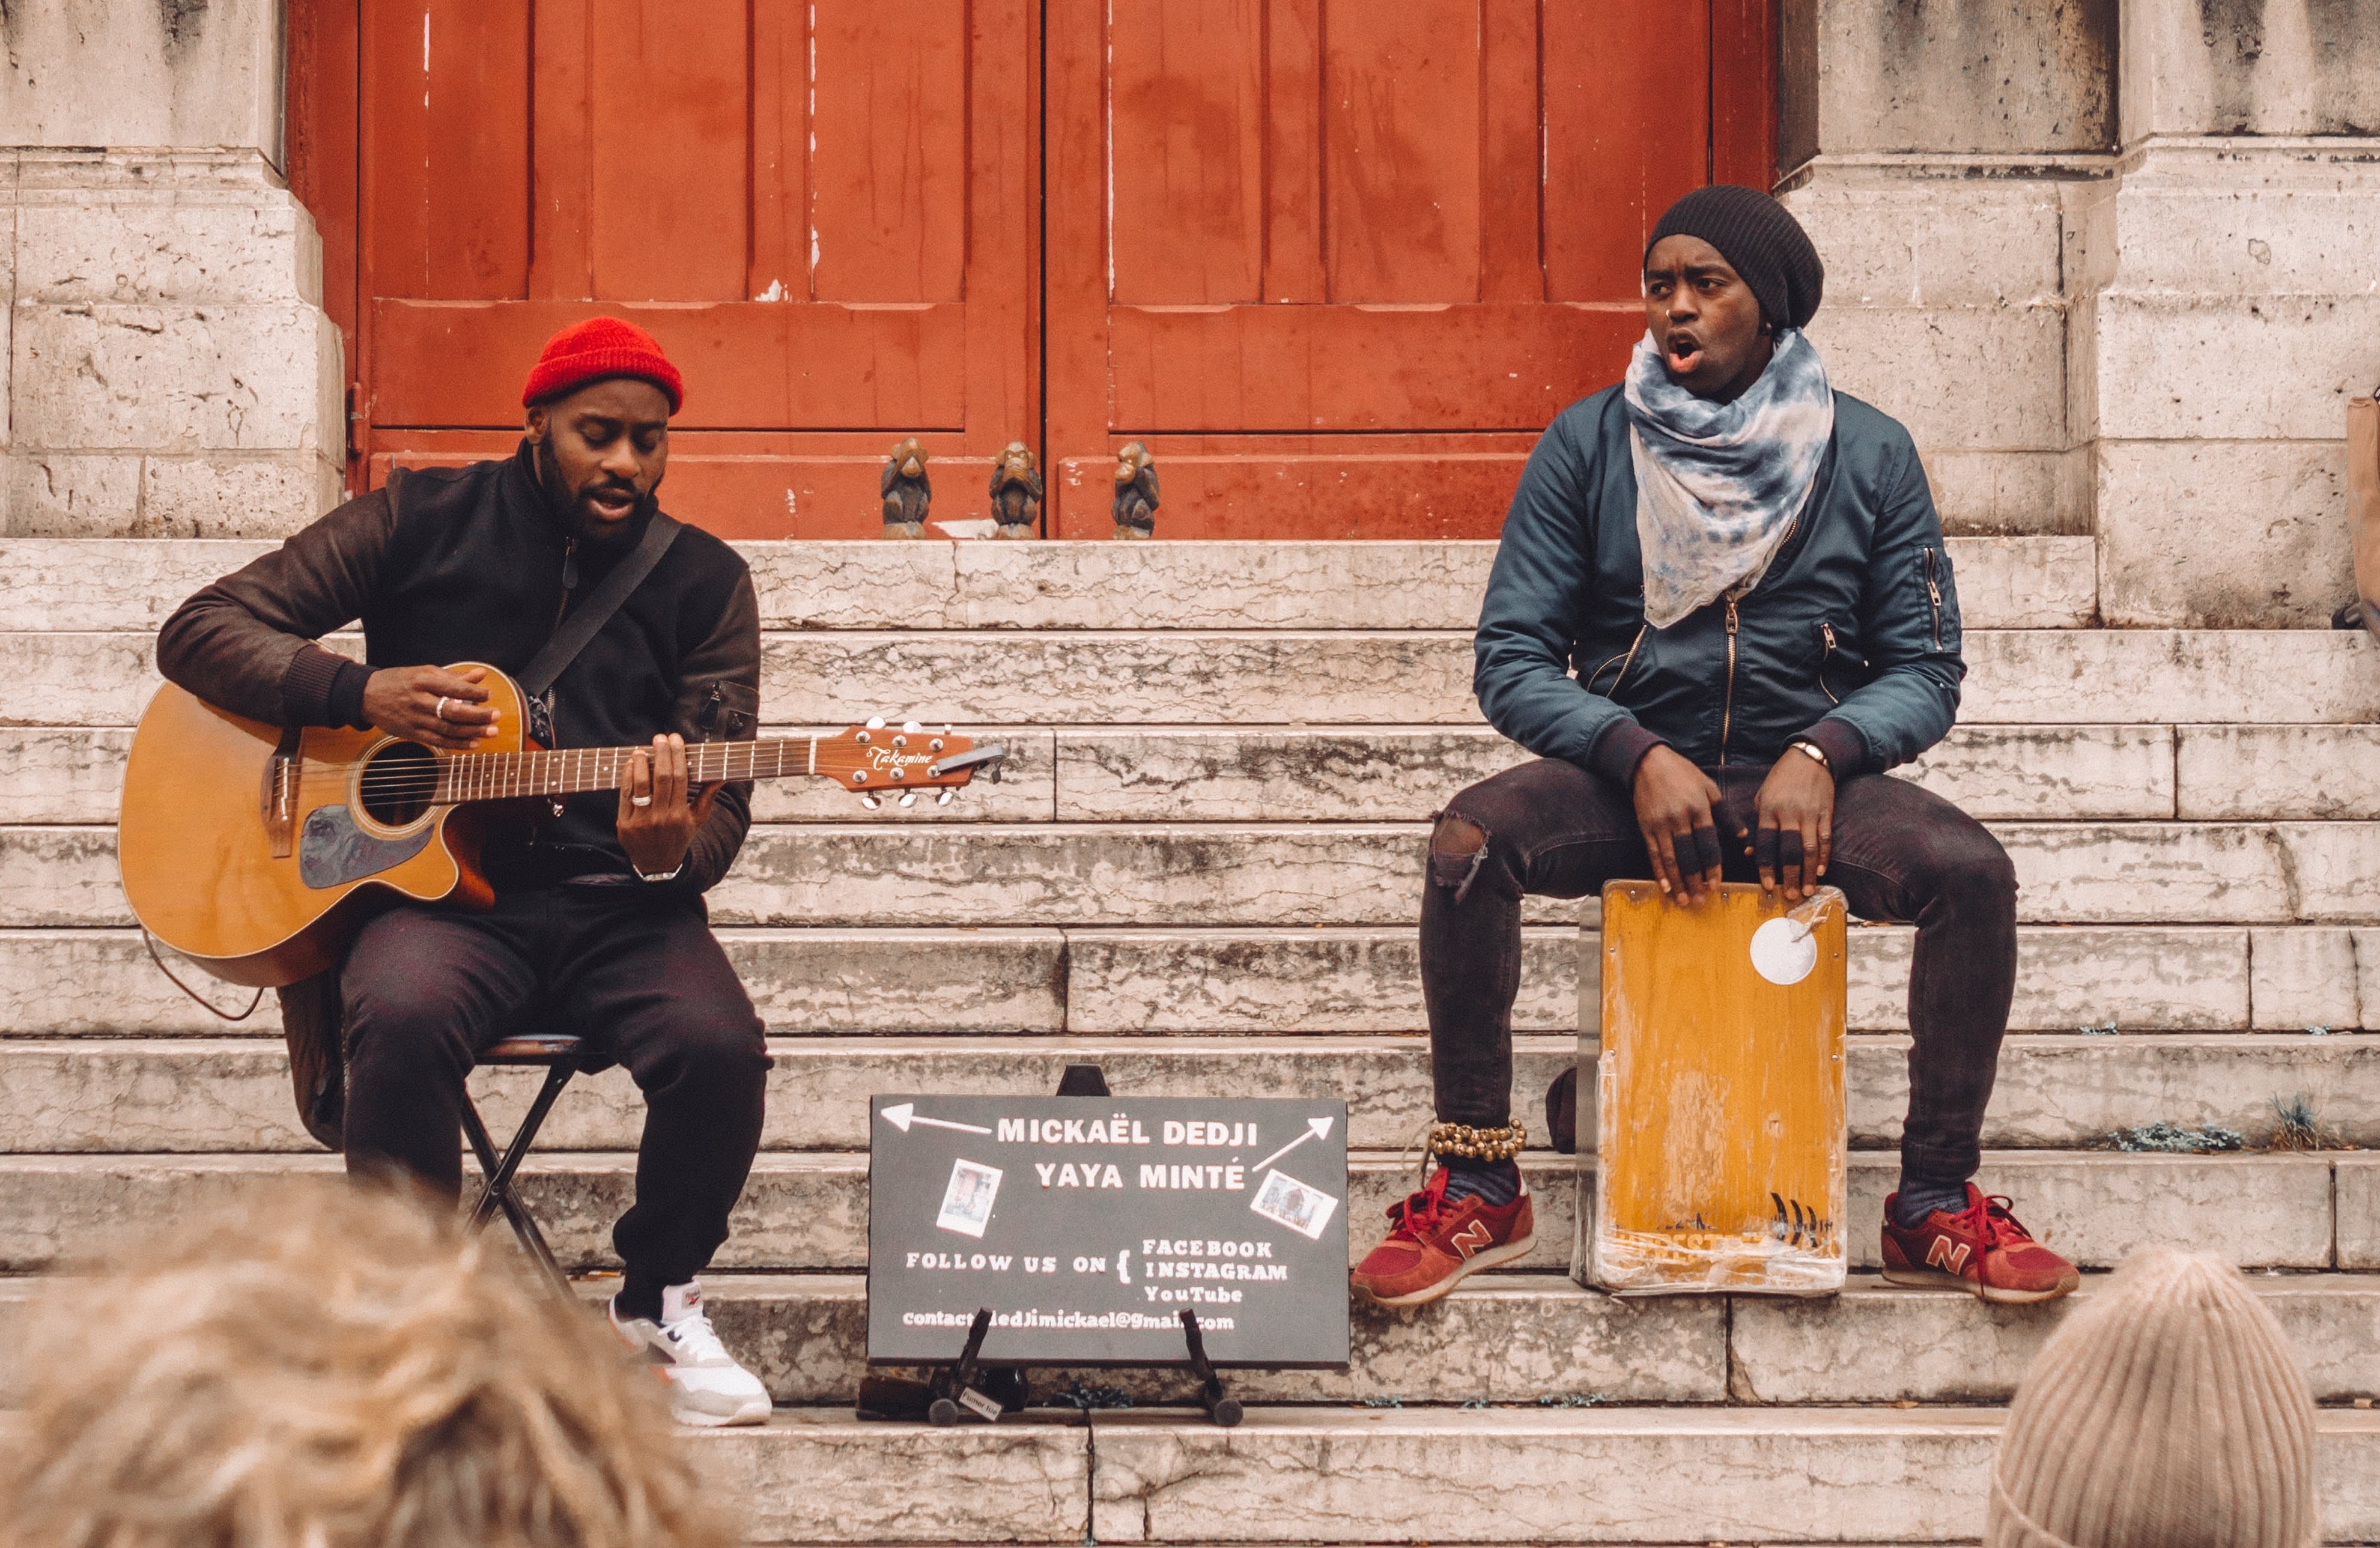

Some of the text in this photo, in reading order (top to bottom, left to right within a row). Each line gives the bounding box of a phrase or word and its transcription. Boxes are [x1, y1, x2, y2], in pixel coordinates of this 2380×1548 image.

[866, 746, 933, 771] Takamine
[998, 1113, 1257, 1147] MICKAËL DEDJI
[1034, 1156, 1245, 1190] YAYA MINTÉ
[1142, 1239, 1272, 1258] FACEBOOK
[1451, 1219, 1494, 1261] N
[906, 1252, 1013, 1272] FOLLOW
[1024, 1256, 1057, 1273] US
[1073, 1256, 1107, 1273] ON
[1925, 1234, 1971, 1276] N
[1145, 1261, 1288, 1281] INSTAGRAM
[1144, 1285, 1243, 1304] YouTube
